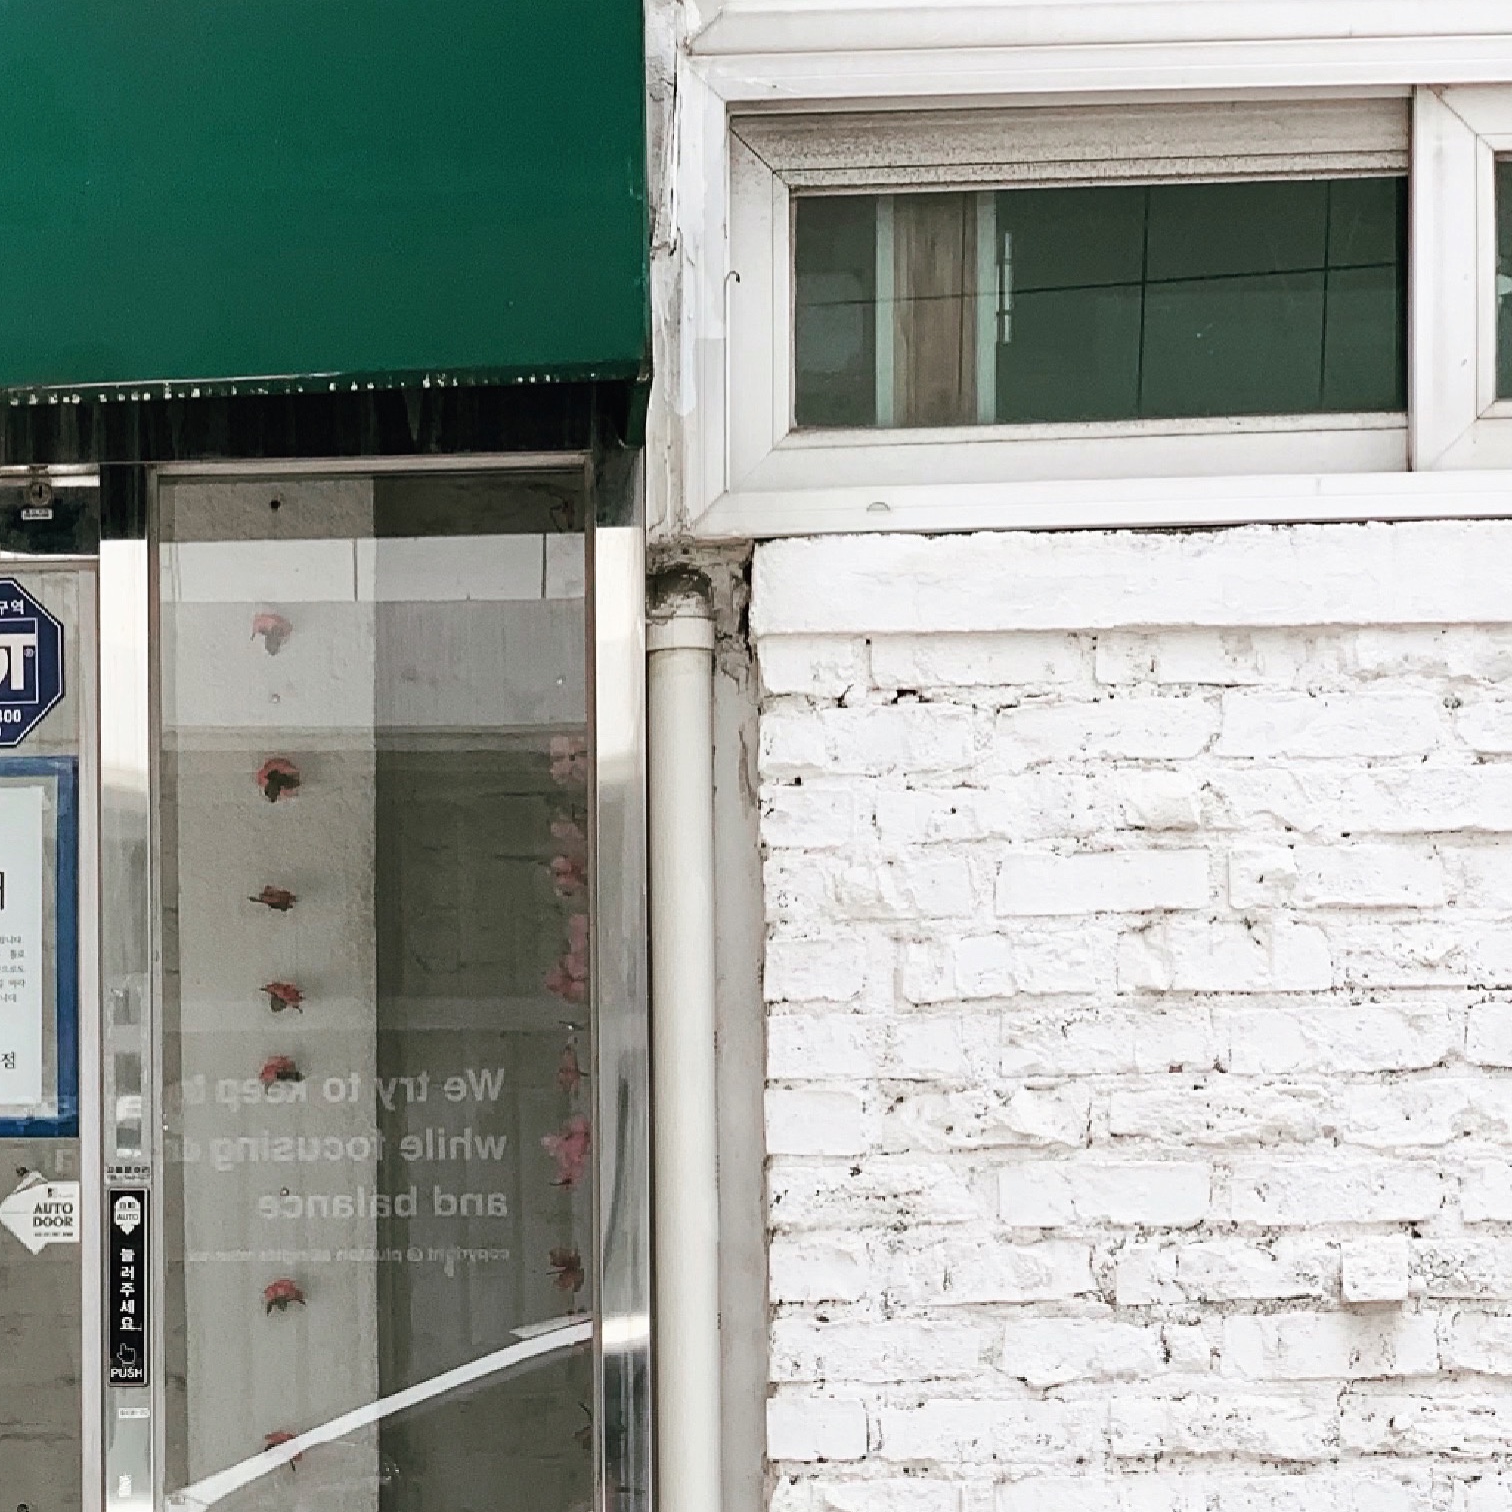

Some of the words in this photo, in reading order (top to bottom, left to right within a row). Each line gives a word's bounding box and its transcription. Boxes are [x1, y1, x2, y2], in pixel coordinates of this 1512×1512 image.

[33, 1202, 74, 1215] AUTO
[32, 1216, 73, 1227] DOOR
[110, 1368, 143, 1378] PUSH
